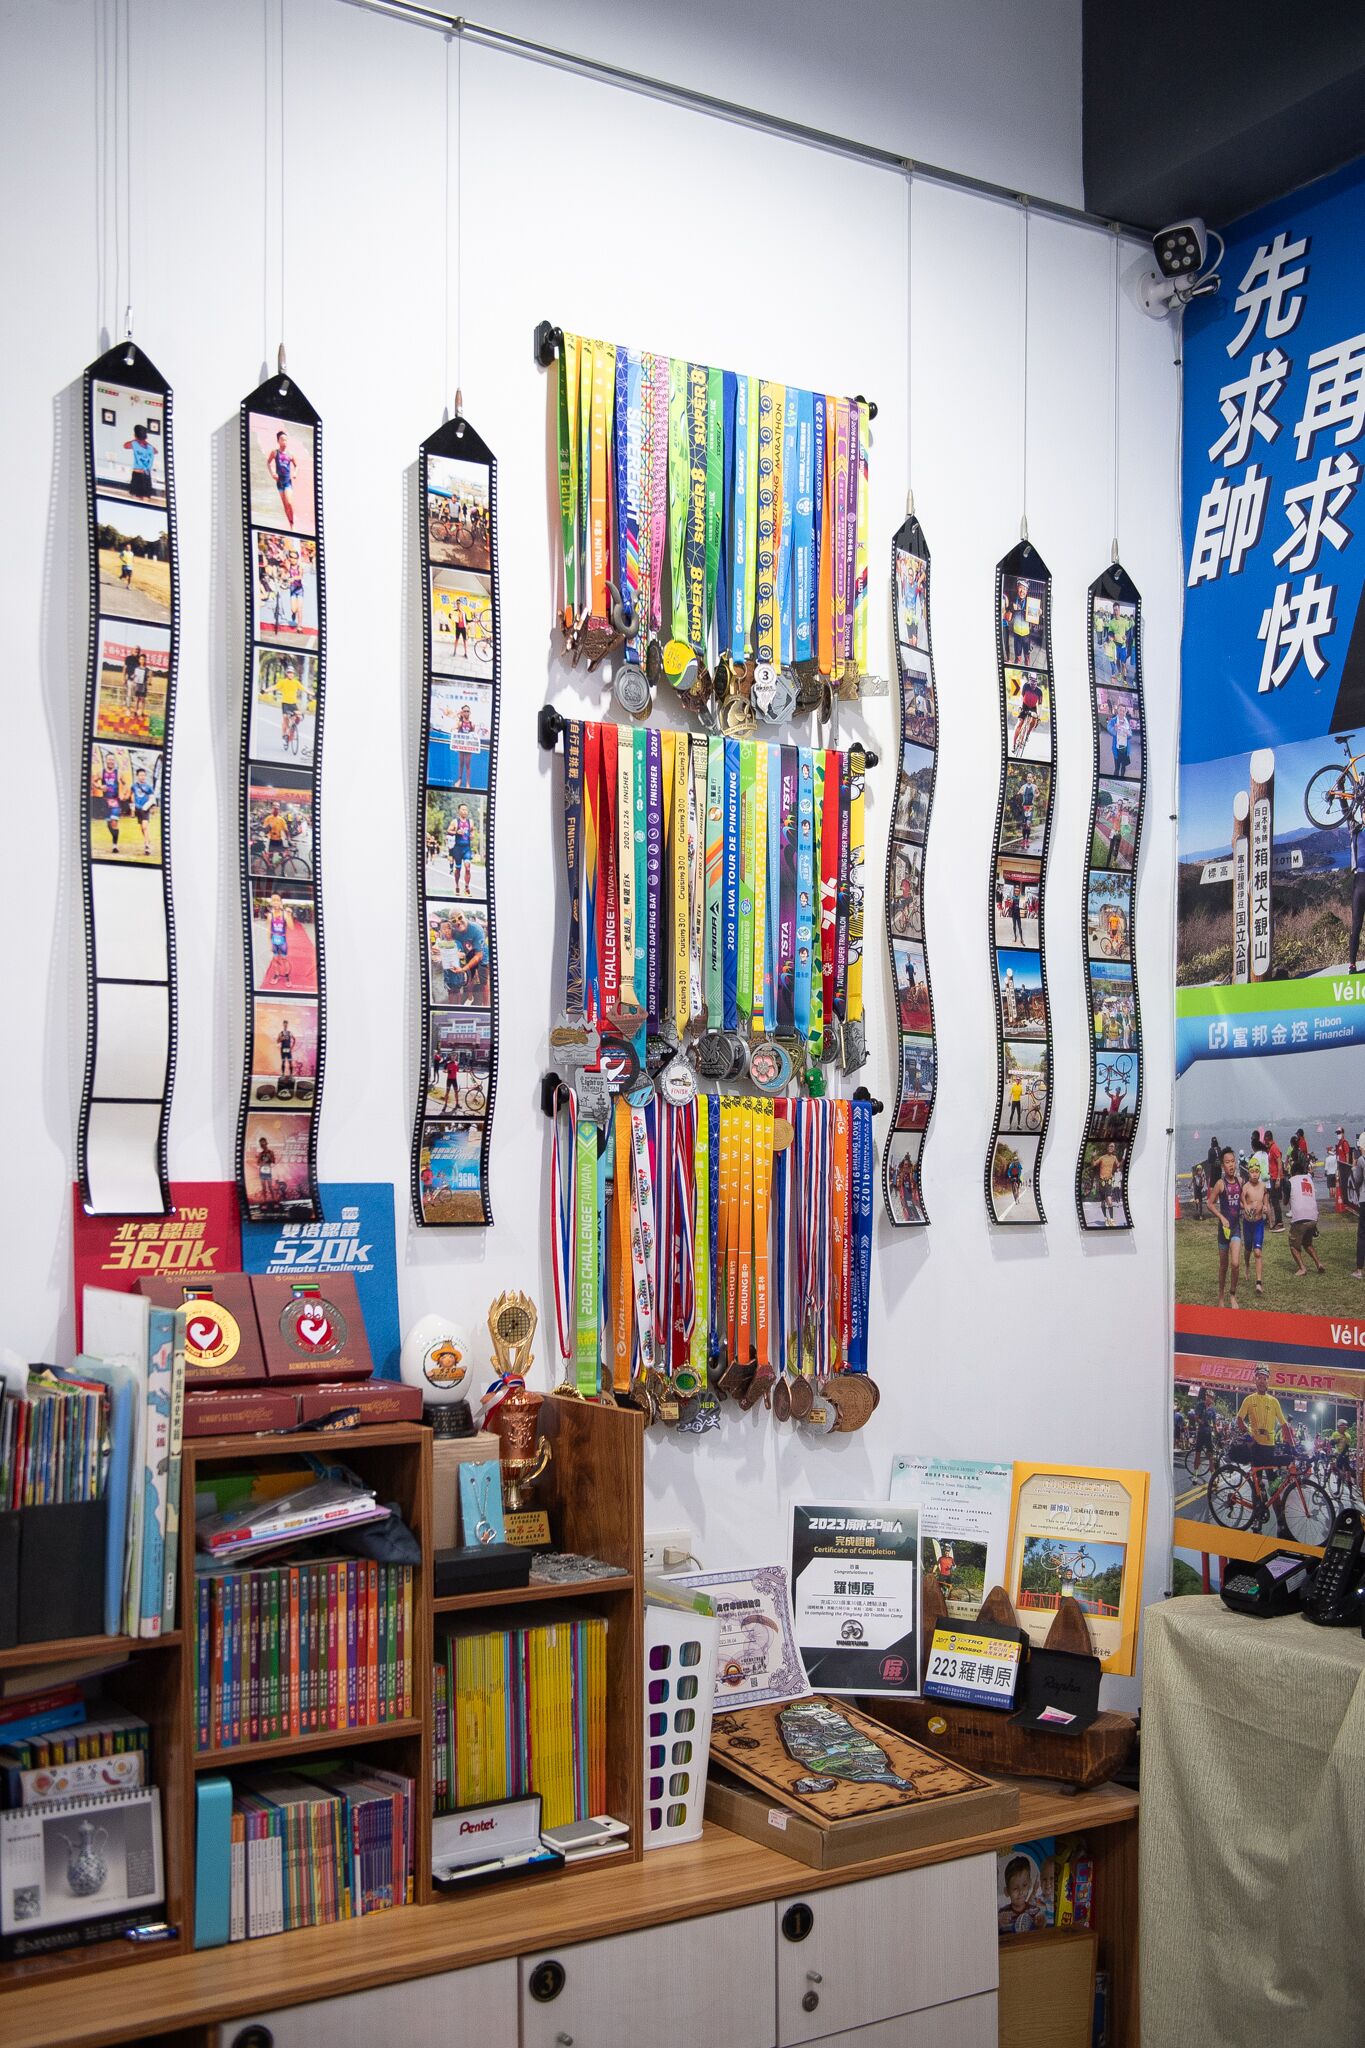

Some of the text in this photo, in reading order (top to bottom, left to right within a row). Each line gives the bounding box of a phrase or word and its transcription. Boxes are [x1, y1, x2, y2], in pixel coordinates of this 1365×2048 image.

[690, 370, 706, 444] SUPER 8
[738, 379, 746, 416] GIANT
[1187, 232, 1307, 587] 先求帥
[774, 403, 782, 469] MARATHON
[627, 407, 641, 524] SUPEREIGHT
[562, 475, 571, 516] TAIPEI
[690, 468, 706, 544] SUPER 8
[1258, 331, 1365, 693] 再求快
[594, 538, 602, 576] YUNLIN
[690, 567, 703, 641] SUPER 8
[762, 671, 769, 680] 3
[678, 742, 687, 785] Cruising 300
[650, 765, 658, 806] FINISHER
[729, 772, 737, 833] PINGTUNG
[678, 798, 687, 842] Cruising 300
[729, 836, 736, 851] DE
[678, 856, 687, 900] Cruising 300
[1254, 848, 1268, 959] 箱根大観山
[678, 913, 687, 957] Cruising 300
[727, 923, 735, 950] 2020
[781, 921, 789, 957] TSTA
[837, 916, 846, 988] TAITUNG SUPER TRIATHLON
[678, 970, 687, 1014] Cruising 300
[1233, 1020, 1307, 1049] 富邦金控
[1314, 1016, 1341, 1028] Fubon
[1314, 1025, 1354, 1041] Financial
[862, 1174, 870, 1201] 2016
[114, 1223, 206, 1240] 北高認證
[179, 1208, 208, 1220] TWB
[281, 1222, 361, 1238] 雙塔認證
[101, 1240, 219, 1270] 360k
[270, 1239, 373, 1264] 520k
[579, 1164, 592, 1315] 2023 CHALLENGETAIWAN
[266, 1264, 374, 1274] Ultimate Challenge
[758, 1293, 766, 1329] YUNLIN
[1275, 1372, 1335, 1389] START
[814, 1546, 848, 1554] Certificate
[835, 1536, 875, 1547] 完成證明
[834, 1581, 874, 1595] 羅博原
[932, 1657, 1012, 1687] 223 羅博原
[459, 1818, 496, 1836] Pentel
[794, 1913, 801, 1934] 1
[540, 1970, 554, 1994] 3
